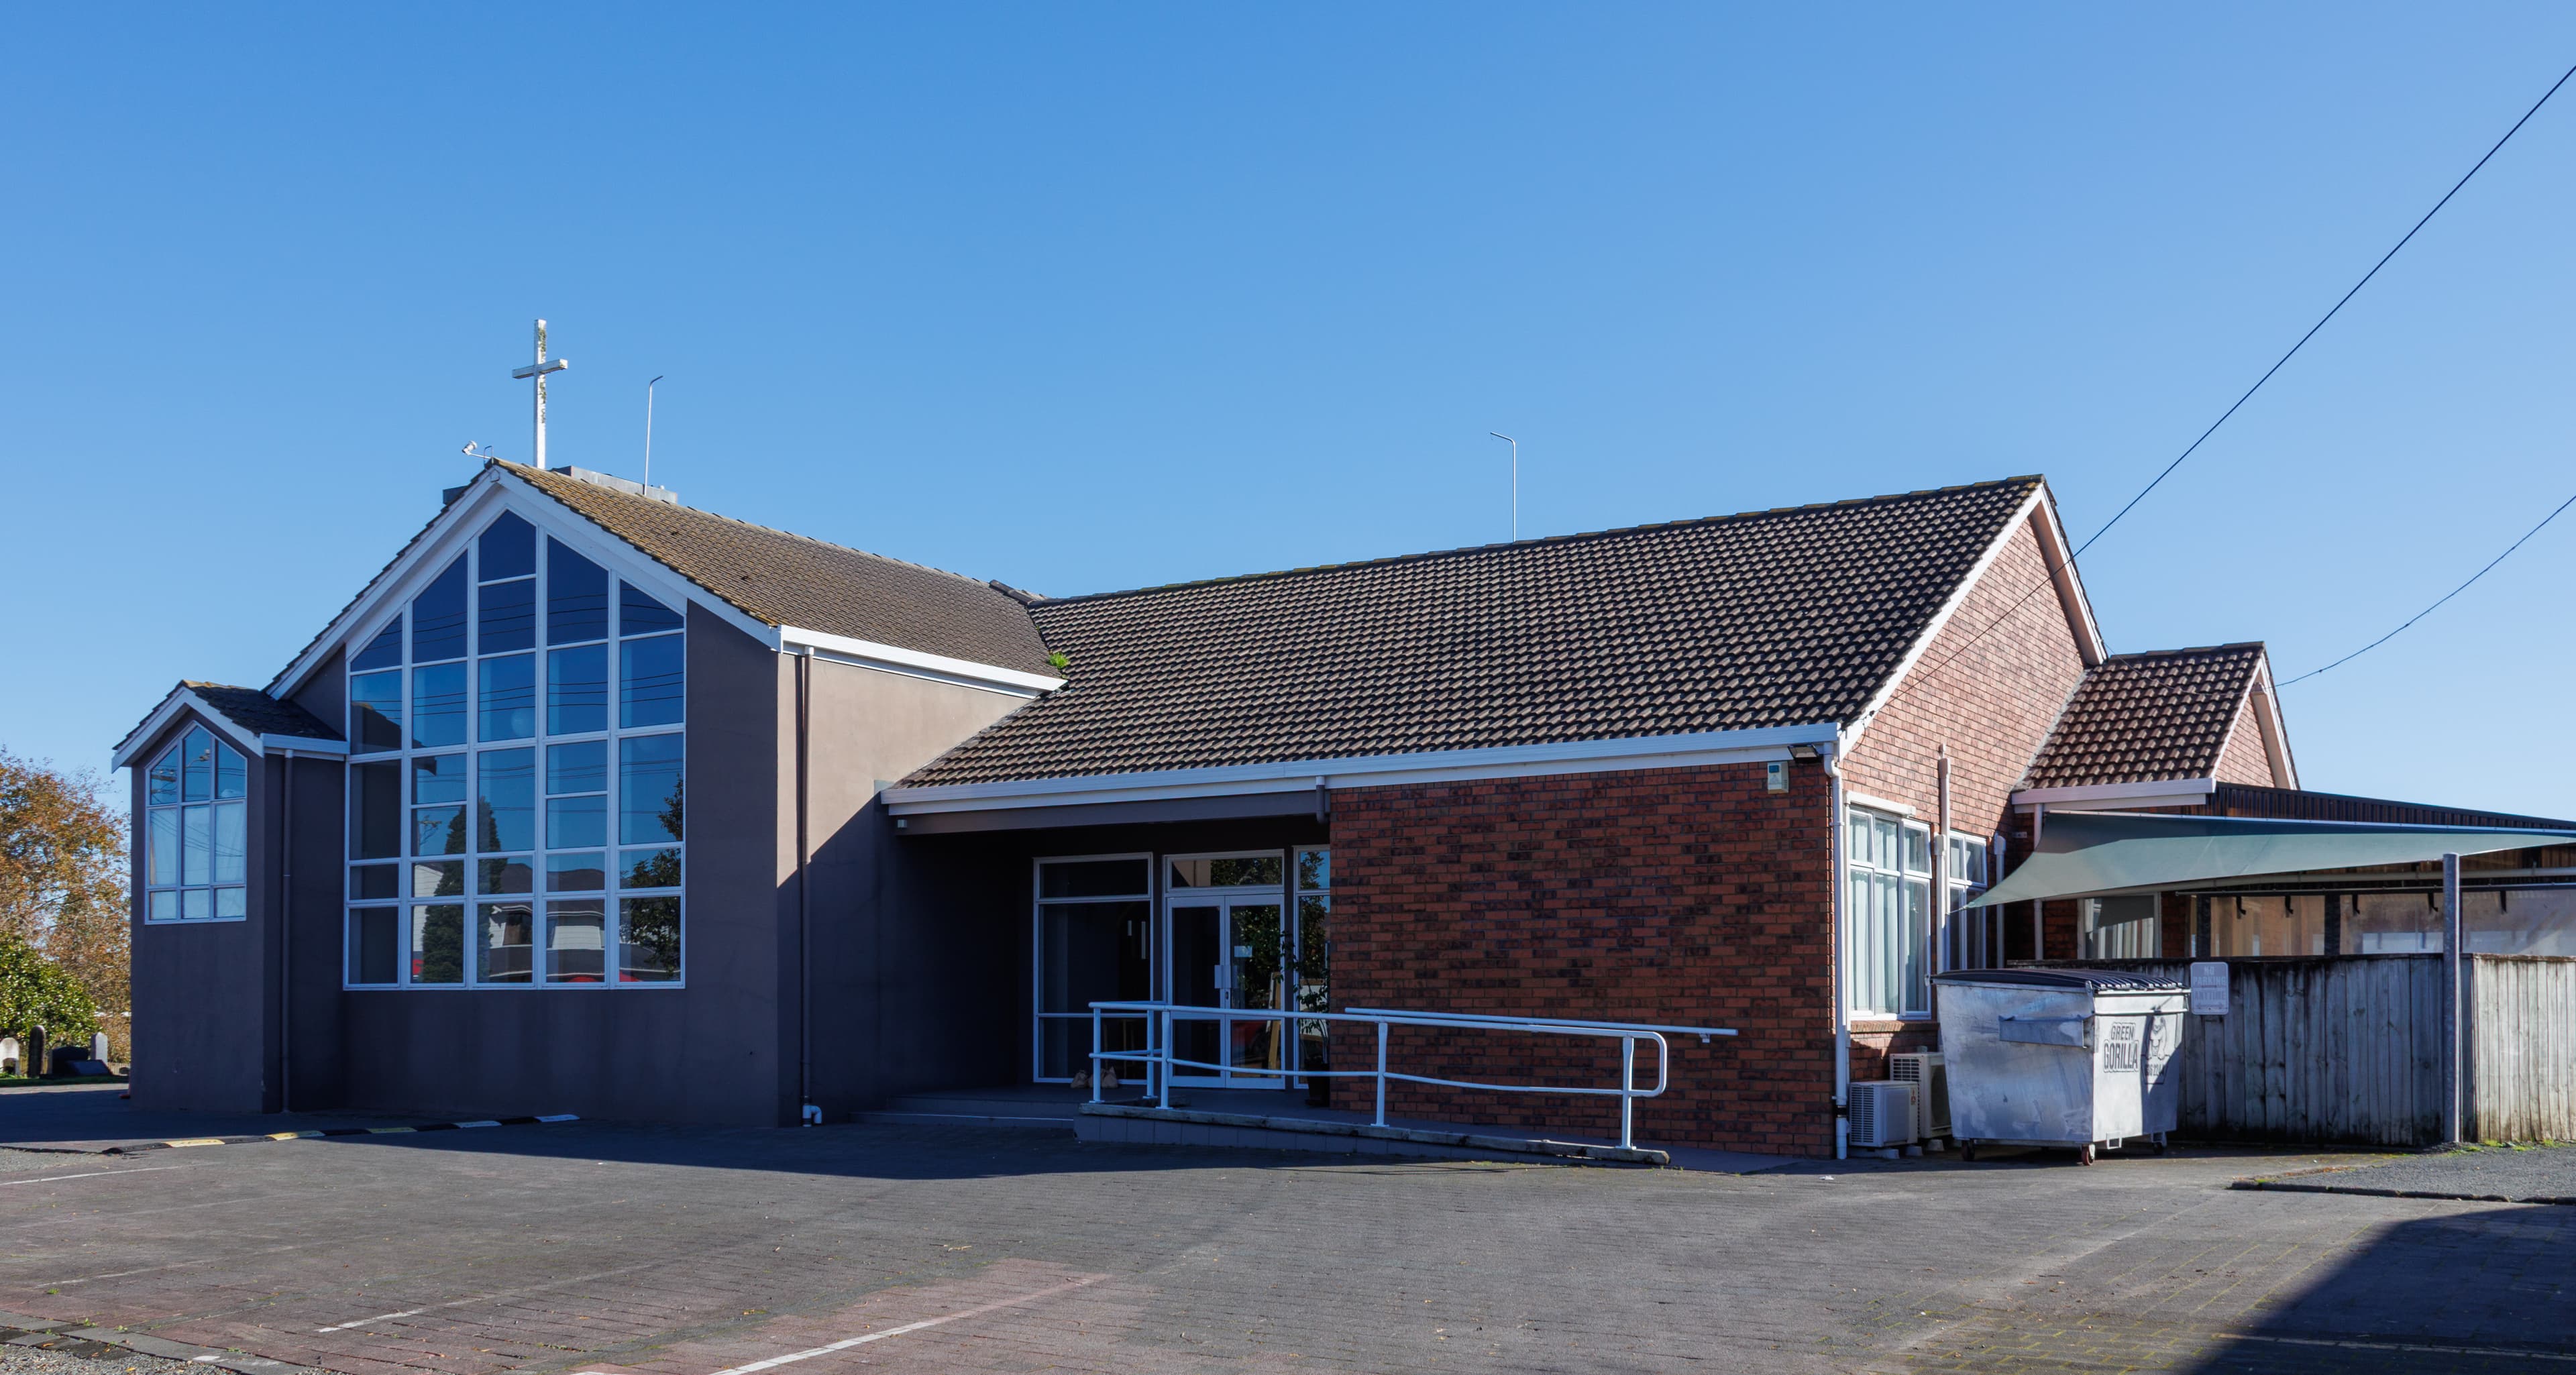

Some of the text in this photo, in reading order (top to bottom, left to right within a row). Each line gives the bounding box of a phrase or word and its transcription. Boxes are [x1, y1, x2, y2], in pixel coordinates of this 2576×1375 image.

[2204, 965, 2215, 975] NO
[2193, 976, 2226, 986] PARKING
[2193, 990, 2226, 1000] ANYTIME
[2110, 1025, 2134, 1040] GREEN
[2104, 1042, 2138, 1069] GORILLA
